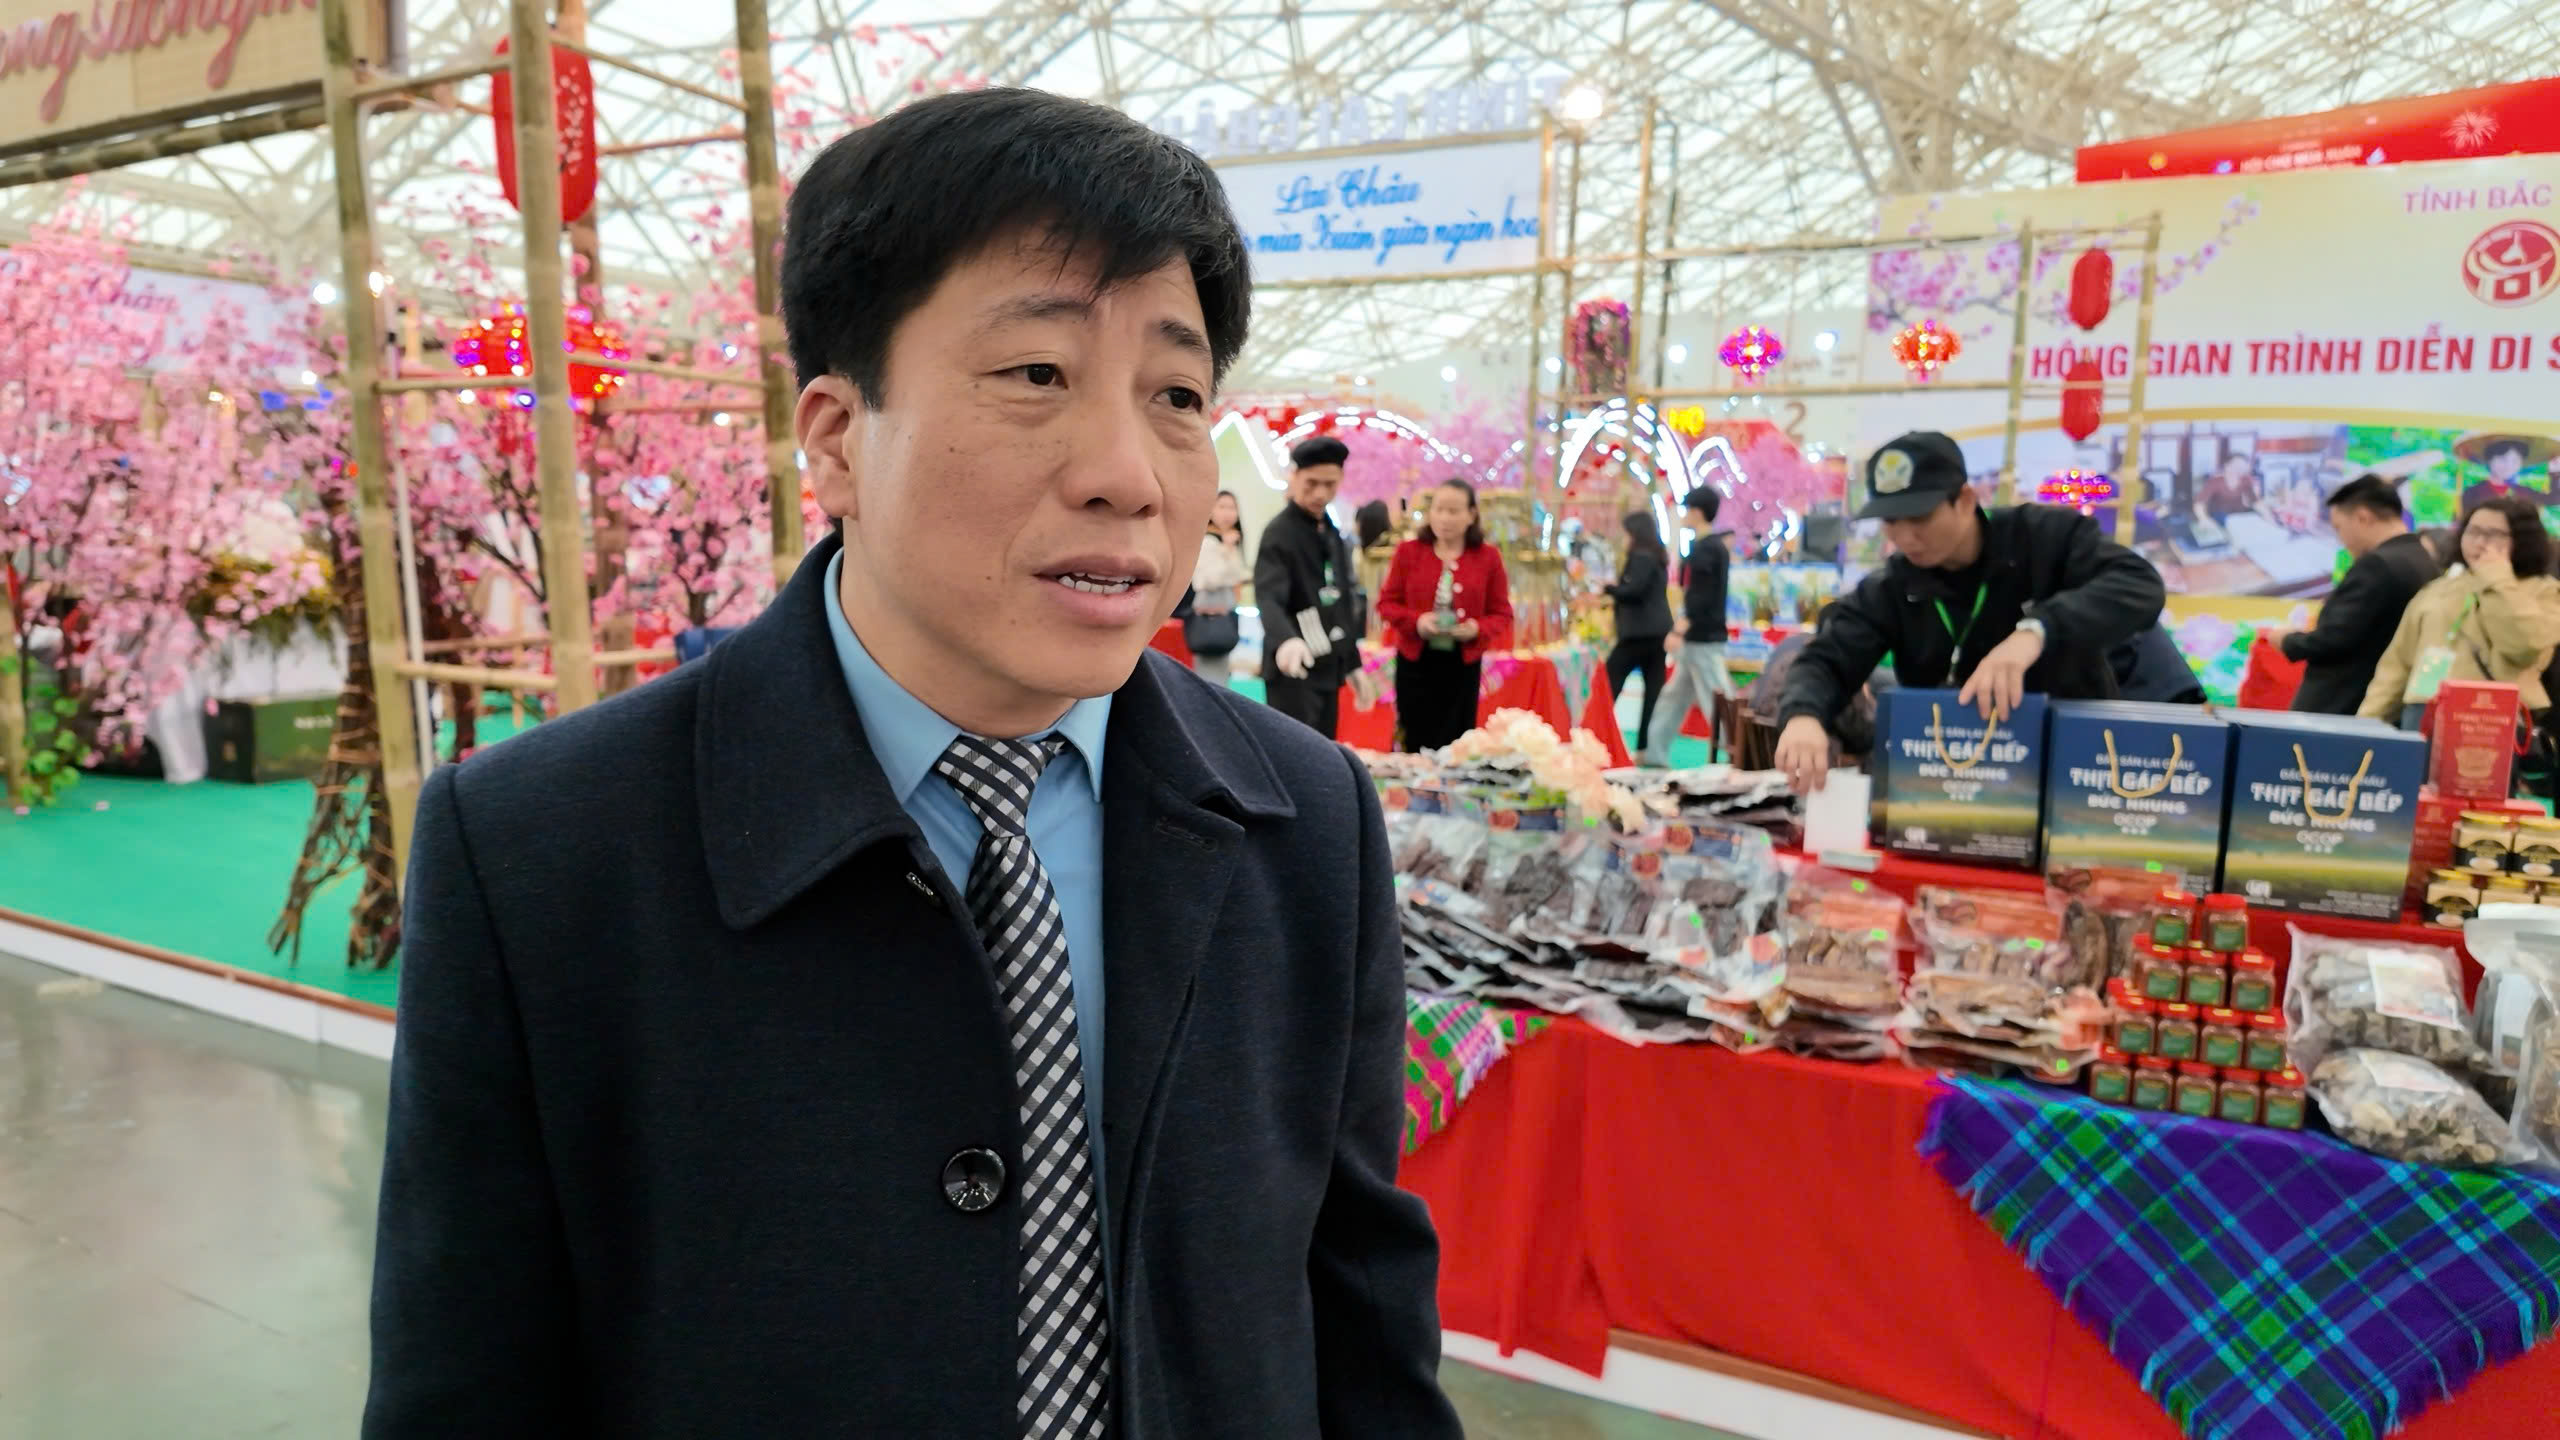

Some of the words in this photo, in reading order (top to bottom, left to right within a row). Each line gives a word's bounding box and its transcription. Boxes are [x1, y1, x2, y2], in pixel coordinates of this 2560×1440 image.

[1273, 175, 1331, 215] Lai
[1336, 164, 1421, 209] Châu
[1501, 195, 1539, 238] hoa
[2147, 341, 2231, 377] GIAN
[2247, 331, 2362, 376] TRÌNH
[2376, 322, 2475, 373] DIỄN
[2489, 335, 2533, 372] DI
[2069, 767, 2113, 791] THỊT
[2251, 782, 2303, 807] THỊT
